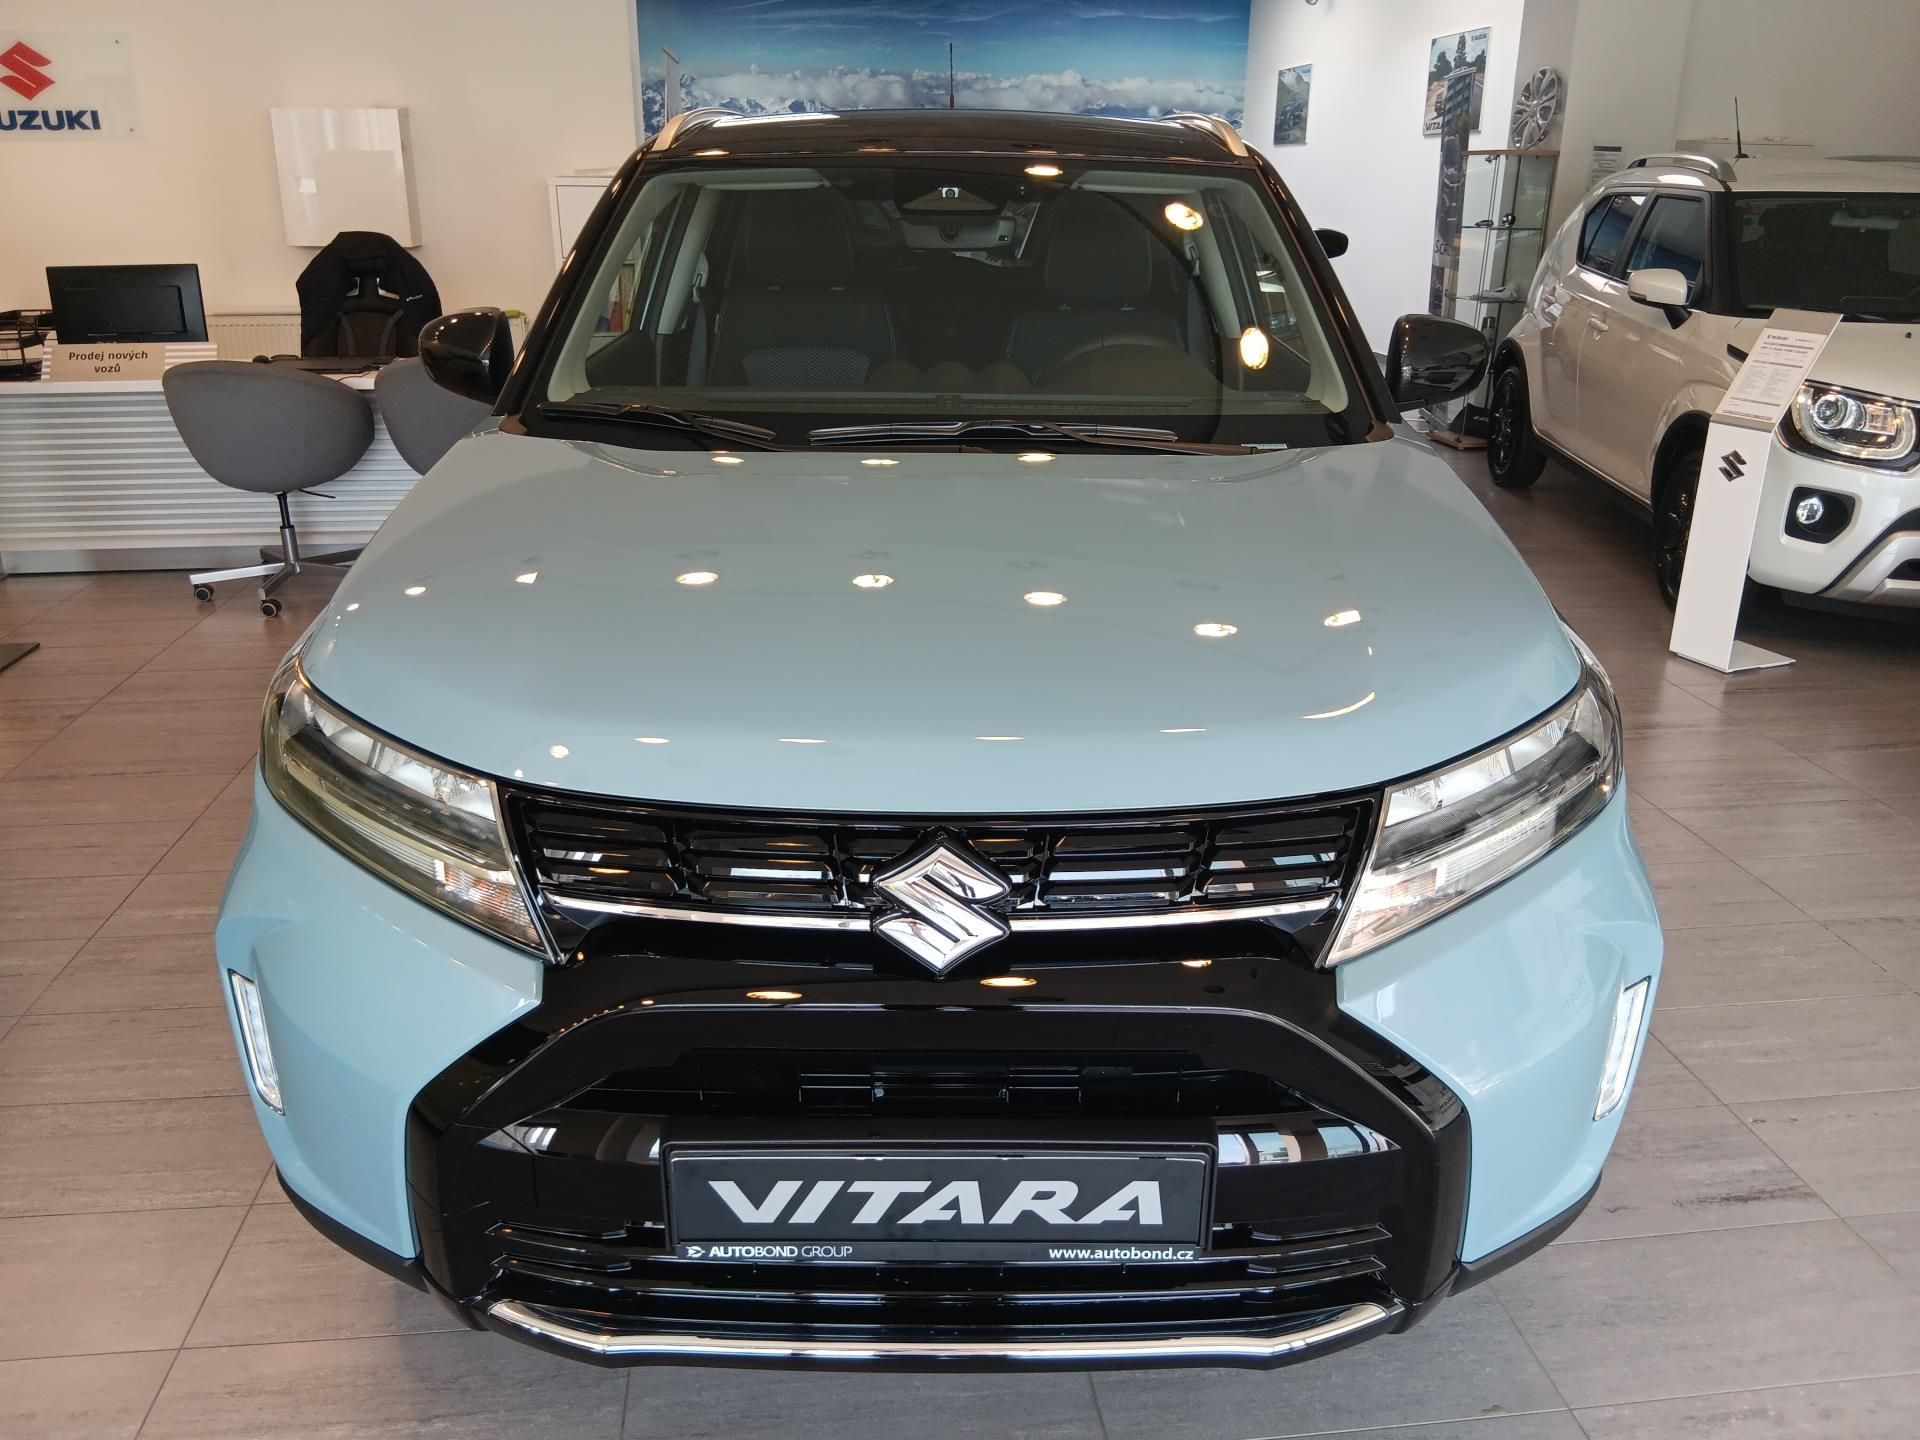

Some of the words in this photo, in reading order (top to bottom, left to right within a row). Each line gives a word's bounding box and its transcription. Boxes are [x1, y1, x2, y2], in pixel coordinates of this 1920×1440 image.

[0, 110, 101, 131] UZUKI
[68, 351, 105, 362] Prodej
[108, 350, 149, 362] nových
[94, 364, 121, 374] vozů
[708, 1180, 1163, 1224] VITARA
[708, 1245, 799, 1258] AUTOBOND
[801, 1245, 853, 1258] GROUP
[1048, 1246, 1195, 1260] www.autobond.cz
